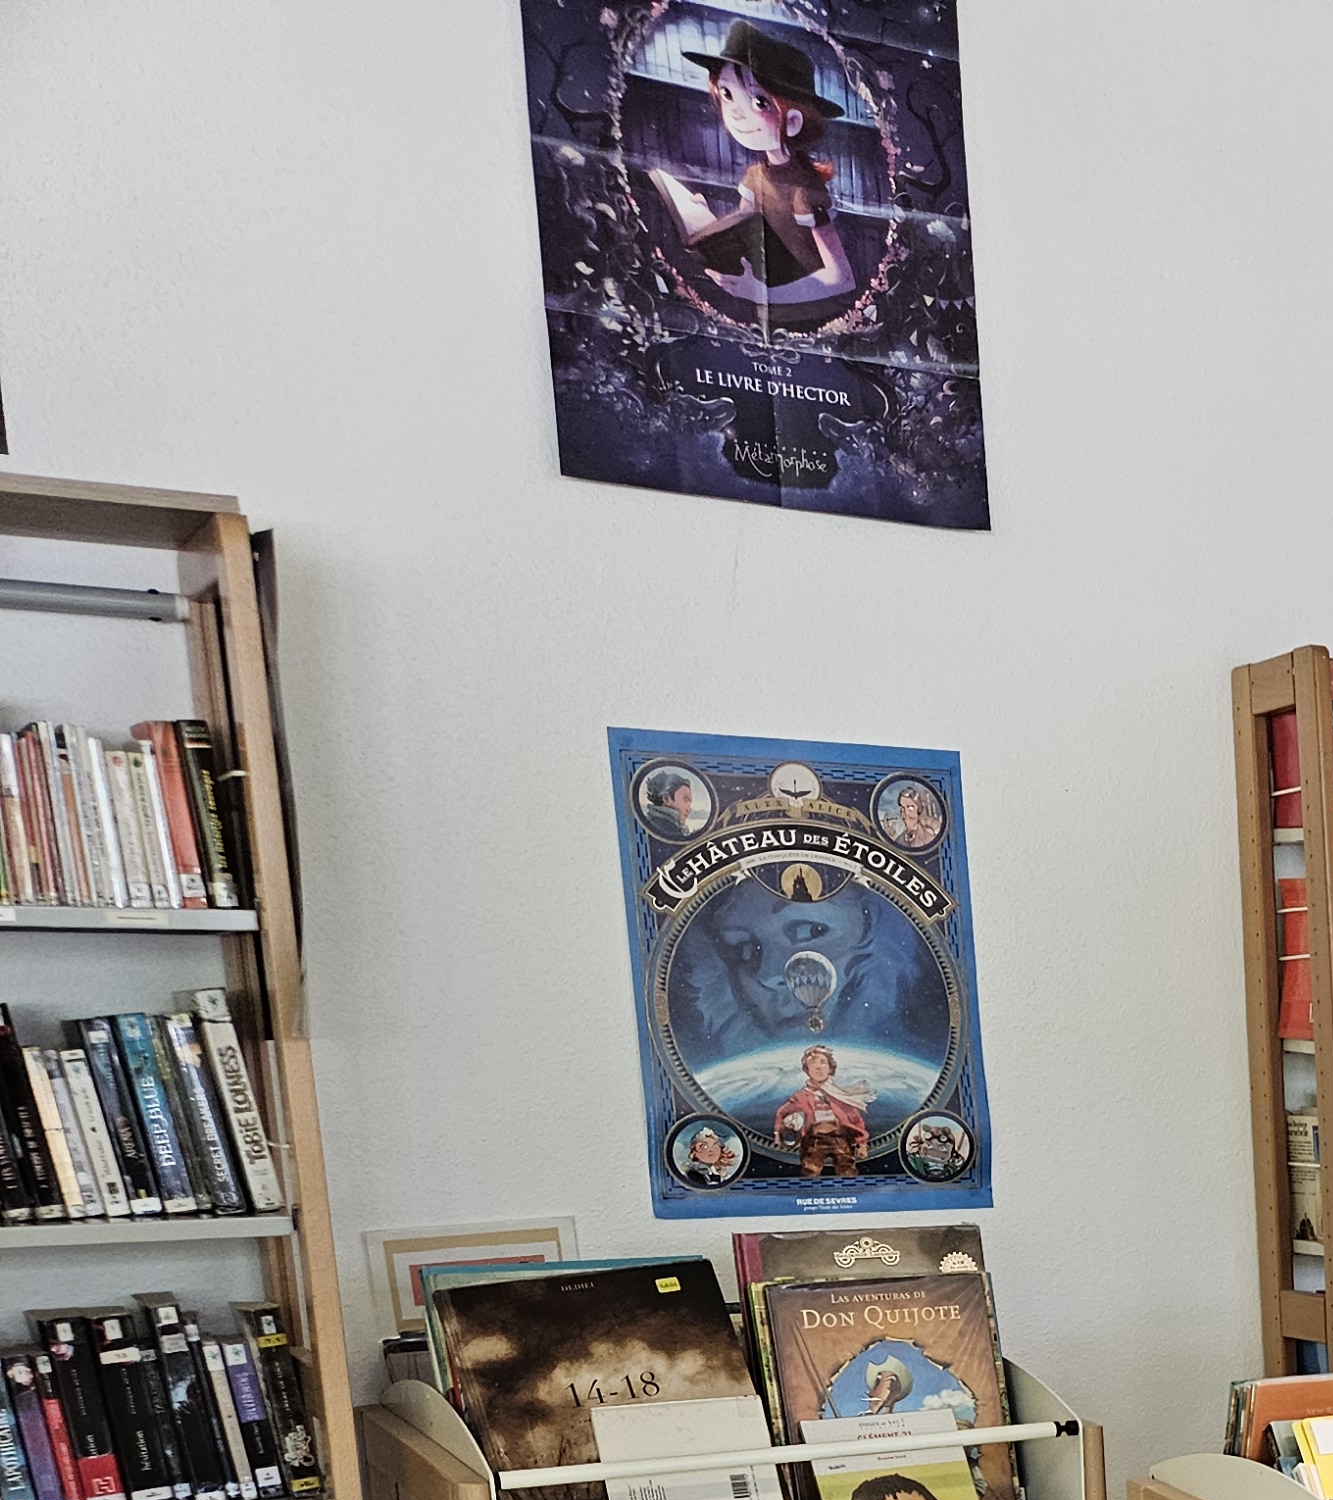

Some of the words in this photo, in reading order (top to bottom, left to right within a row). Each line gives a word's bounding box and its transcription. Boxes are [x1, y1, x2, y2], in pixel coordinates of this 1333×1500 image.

[696, 367, 715, 385] LE
[718, 372, 763, 393] LIVRE
[767, 381, 850, 406] D'HECTOR
[752, 361, 783, 377] TOME
[785, 366, 793, 378] 2
[734, 443, 828, 477] Métamorphose
[659, 828, 797, 899] CHÂTEAU
[803, 833, 829, 846] DES
[832, 832, 938, 908] ÉTOILES
[141, 1077, 163, 1119] BLUE
[152, 1125, 176, 1167] DEEP
[830, 1293, 850, 1304] LAS
[852, 1291, 909, 1303] AVENTURAS
[912, 1290, 927, 1300] DE
[801, 1307, 855, 1330] DON
[863, 1304, 961, 1330] QUIJOTE
[564, 1370, 662, 1408] 14-18
